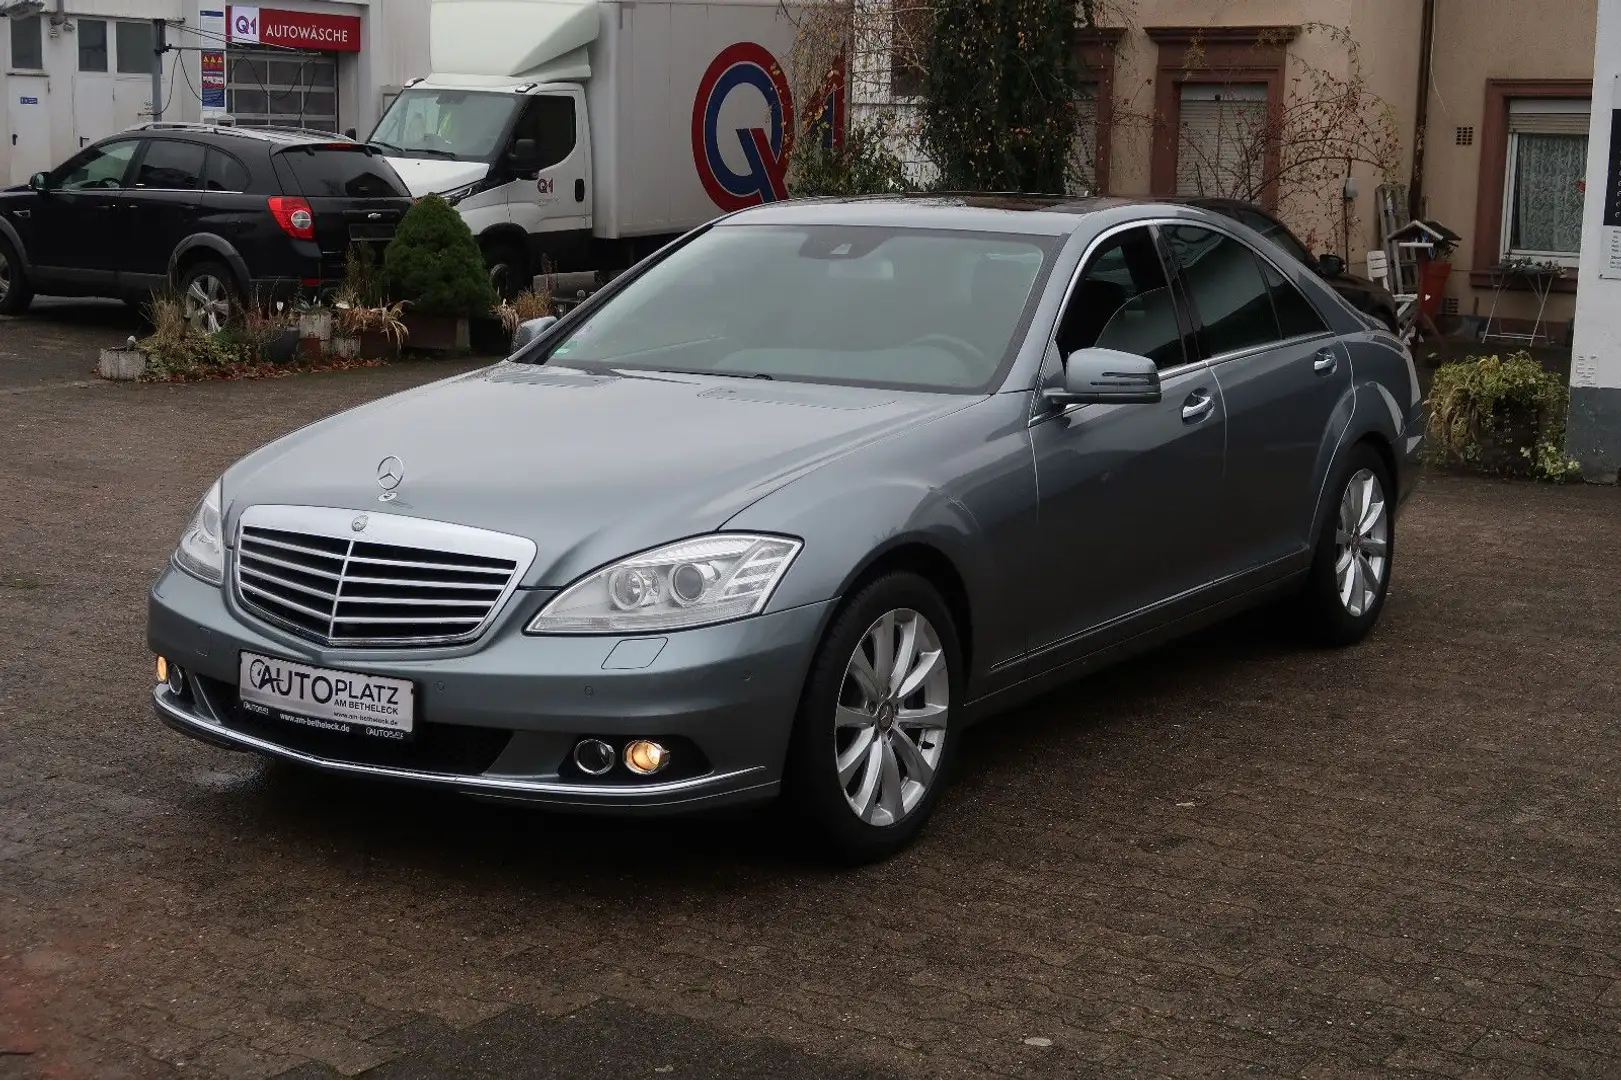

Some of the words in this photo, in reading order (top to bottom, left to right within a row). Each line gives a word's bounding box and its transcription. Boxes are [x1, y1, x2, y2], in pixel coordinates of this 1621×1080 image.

[235, 15, 257, 35] Q1
[265, 24, 348, 43] AUTOWÄSCHE
[537, 178, 554, 194] Q1
[334, 698, 347, 708] AM
[348, 700, 399, 715] BETHELECK
